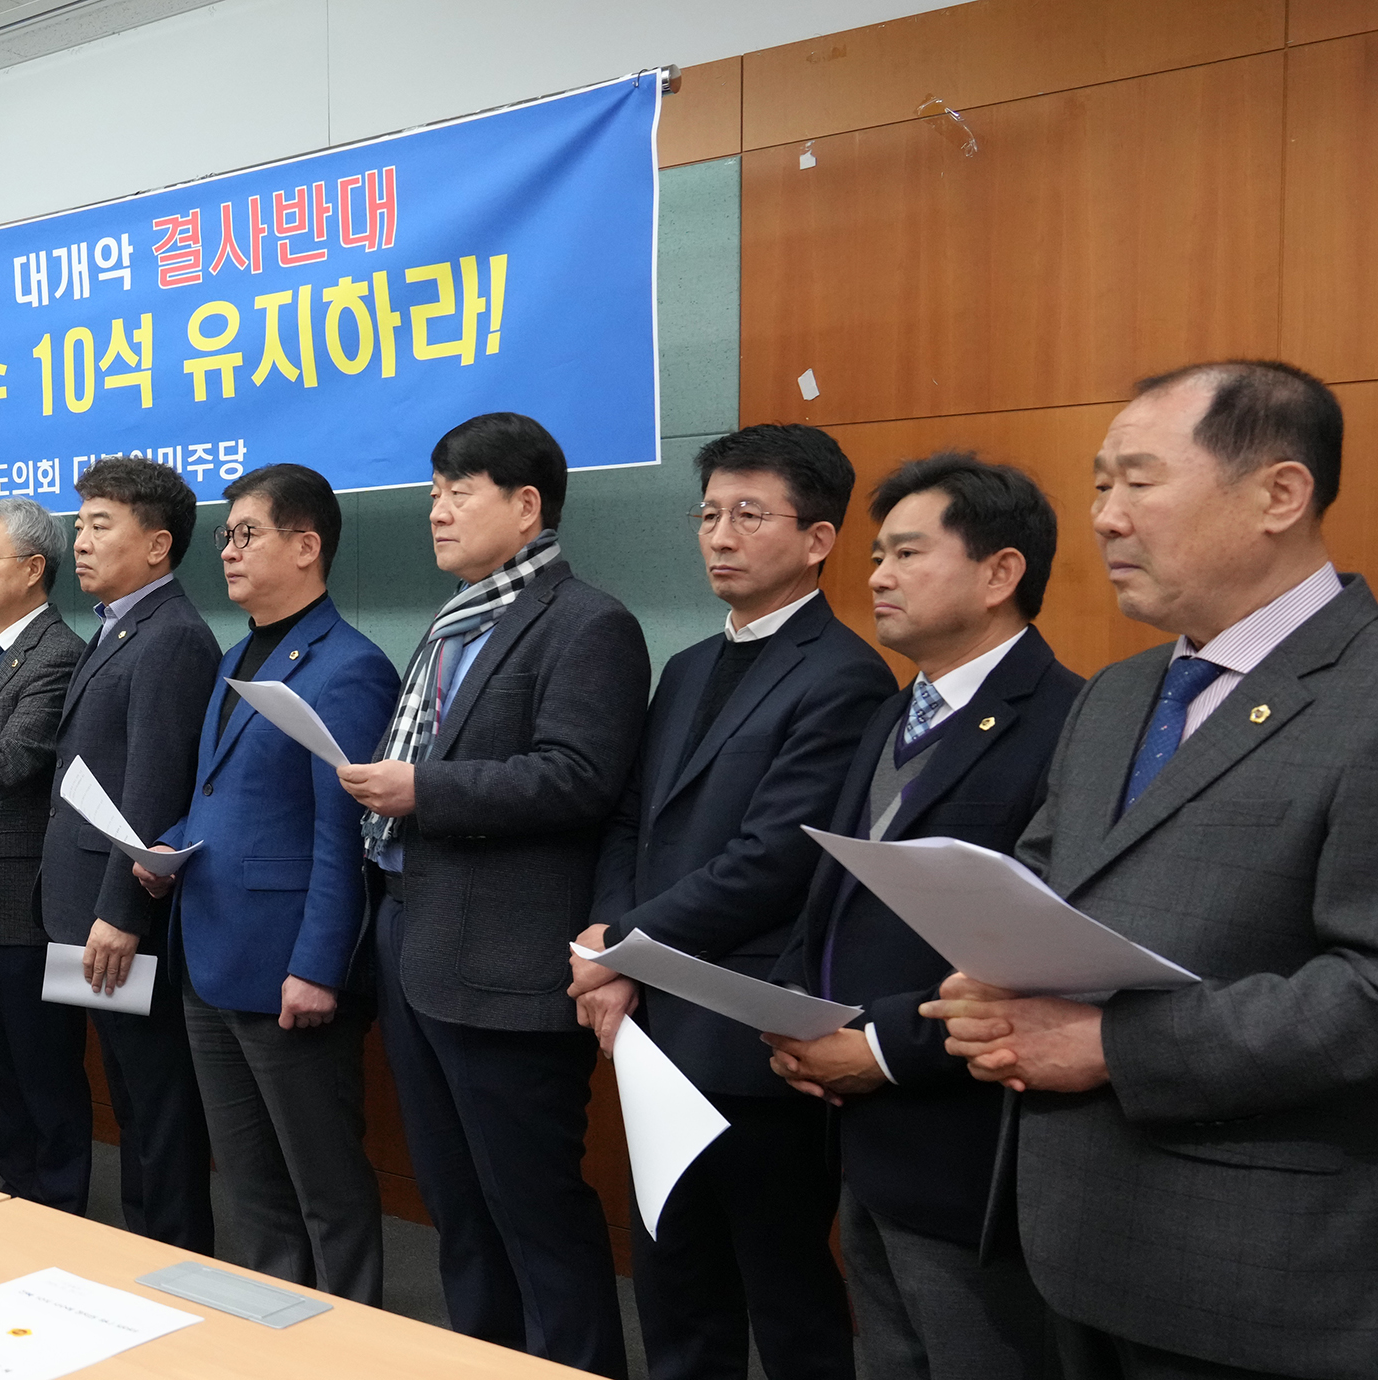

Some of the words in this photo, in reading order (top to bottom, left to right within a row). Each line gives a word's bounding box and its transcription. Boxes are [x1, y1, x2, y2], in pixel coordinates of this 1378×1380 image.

[13, 233, 134, 308] 대개악
[151, 165, 397, 290] 결사반대
[32, 312, 154, 417] 10석
[183, 253, 508, 403] 유지하라!
